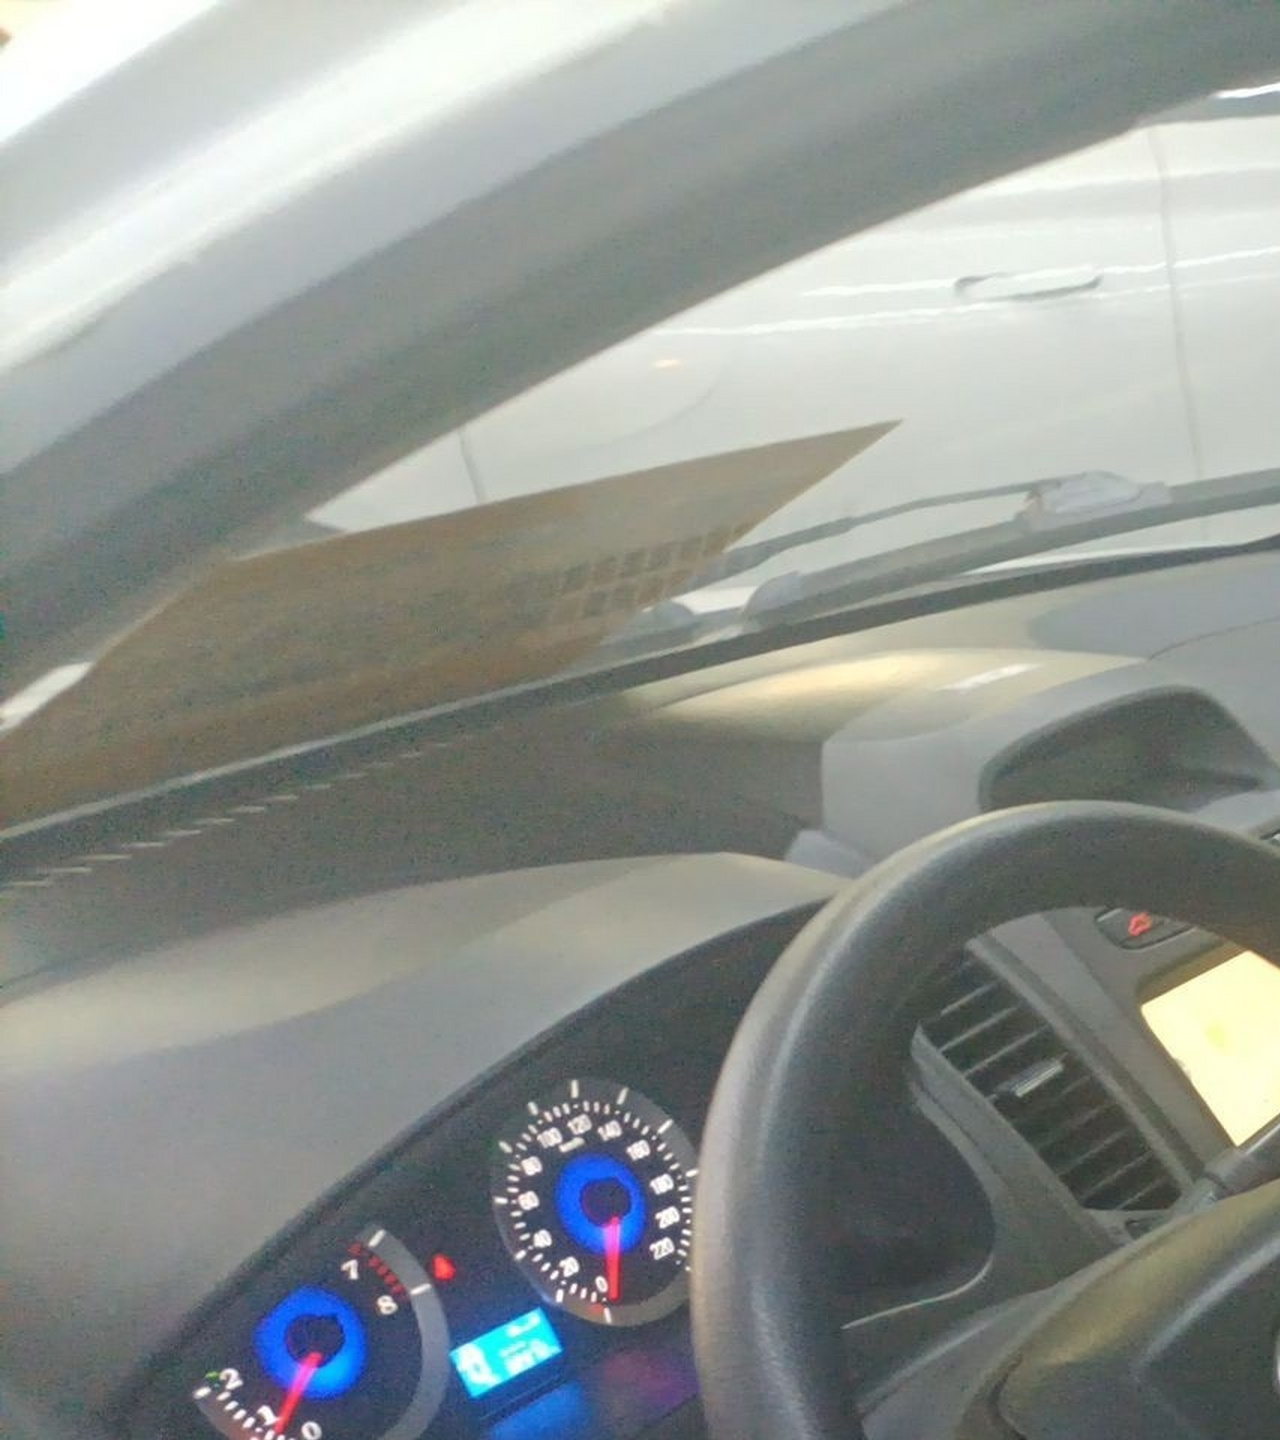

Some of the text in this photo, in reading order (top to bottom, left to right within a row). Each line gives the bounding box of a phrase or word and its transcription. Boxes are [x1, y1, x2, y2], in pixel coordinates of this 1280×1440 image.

[597, 1120, 622, 1141] 140
[655, 1206, 680, 1229] 200
[649, 1237, 675, 1260] 220
[341, 1260, 358, 1280] 7
[559, 1256, 579, 1277] 20
[595, 1276, 608, 1293] 0
[377, 1295, 397, 1314] 8
[220, 1368, 243, 1391] 2
[301, 1421, 321, 1440] 0
